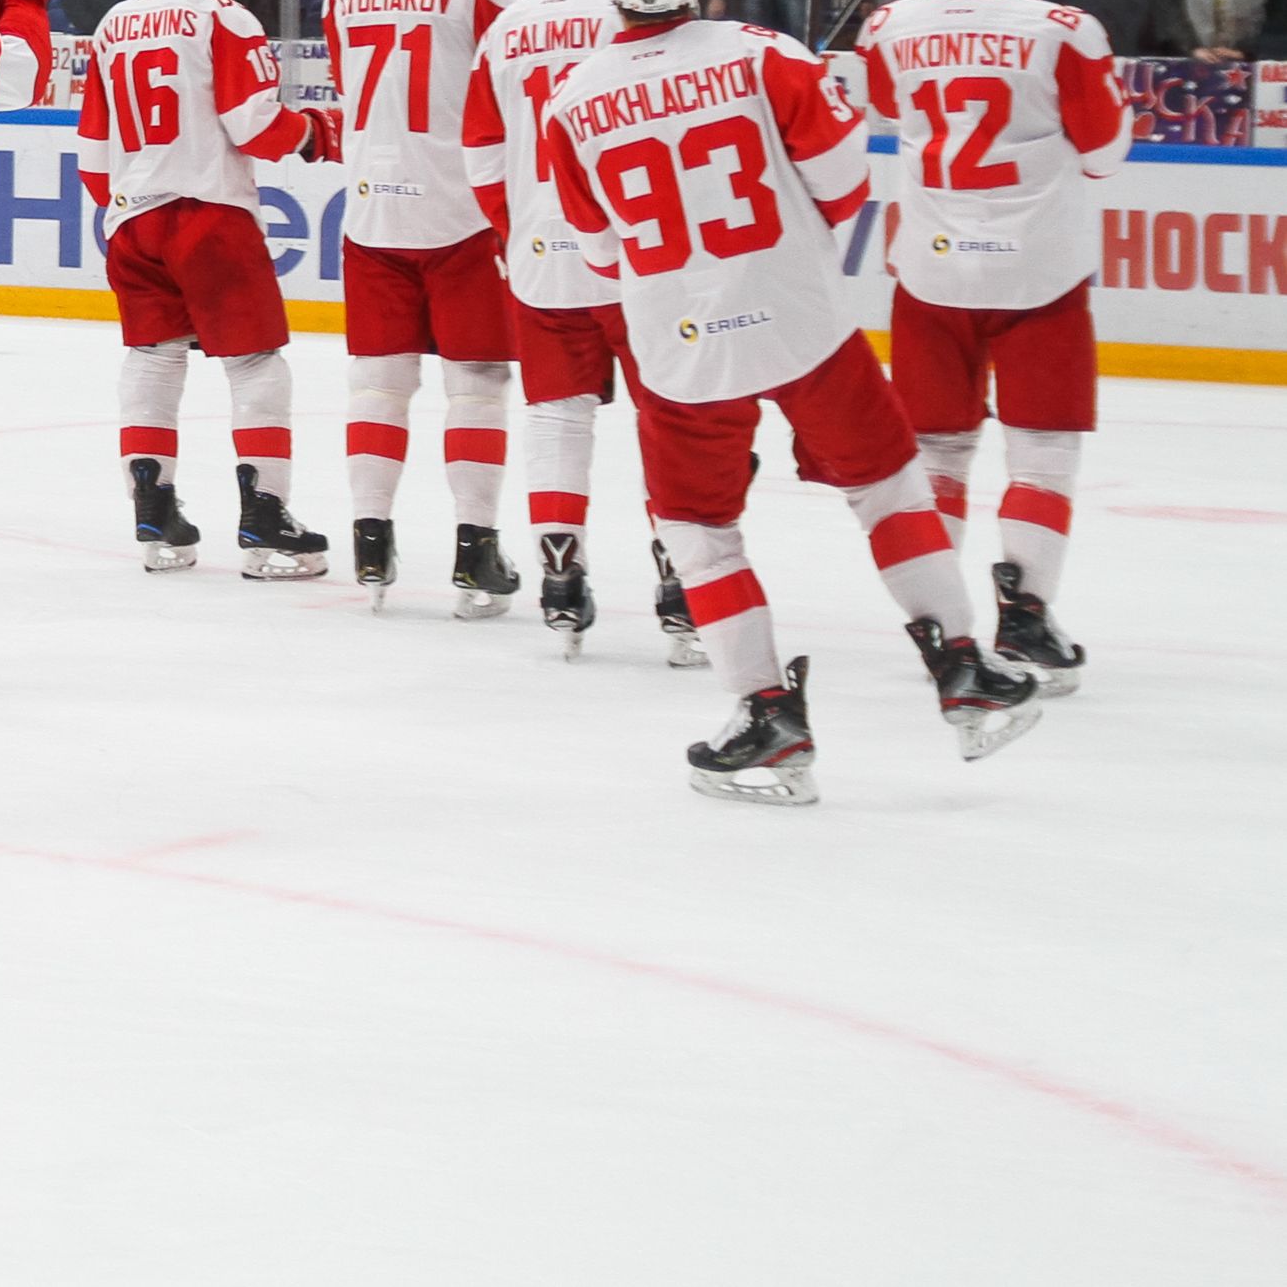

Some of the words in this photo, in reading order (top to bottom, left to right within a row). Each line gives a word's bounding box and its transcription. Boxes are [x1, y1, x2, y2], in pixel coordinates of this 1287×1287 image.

[505, 17, 604, 61] GALIMOV
[245, 45, 279, 84] 16
[347, 23, 433, 134] 71
[110, 47, 181, 154] 16
[911, 76, 1020, 191] 12
[373, 184, 423, 197] ERIELL
[595, 114, 785, 278] 93
[955, 240, 1019, 254] ERIELL
[705, 310, 773, 336] ERIELL
